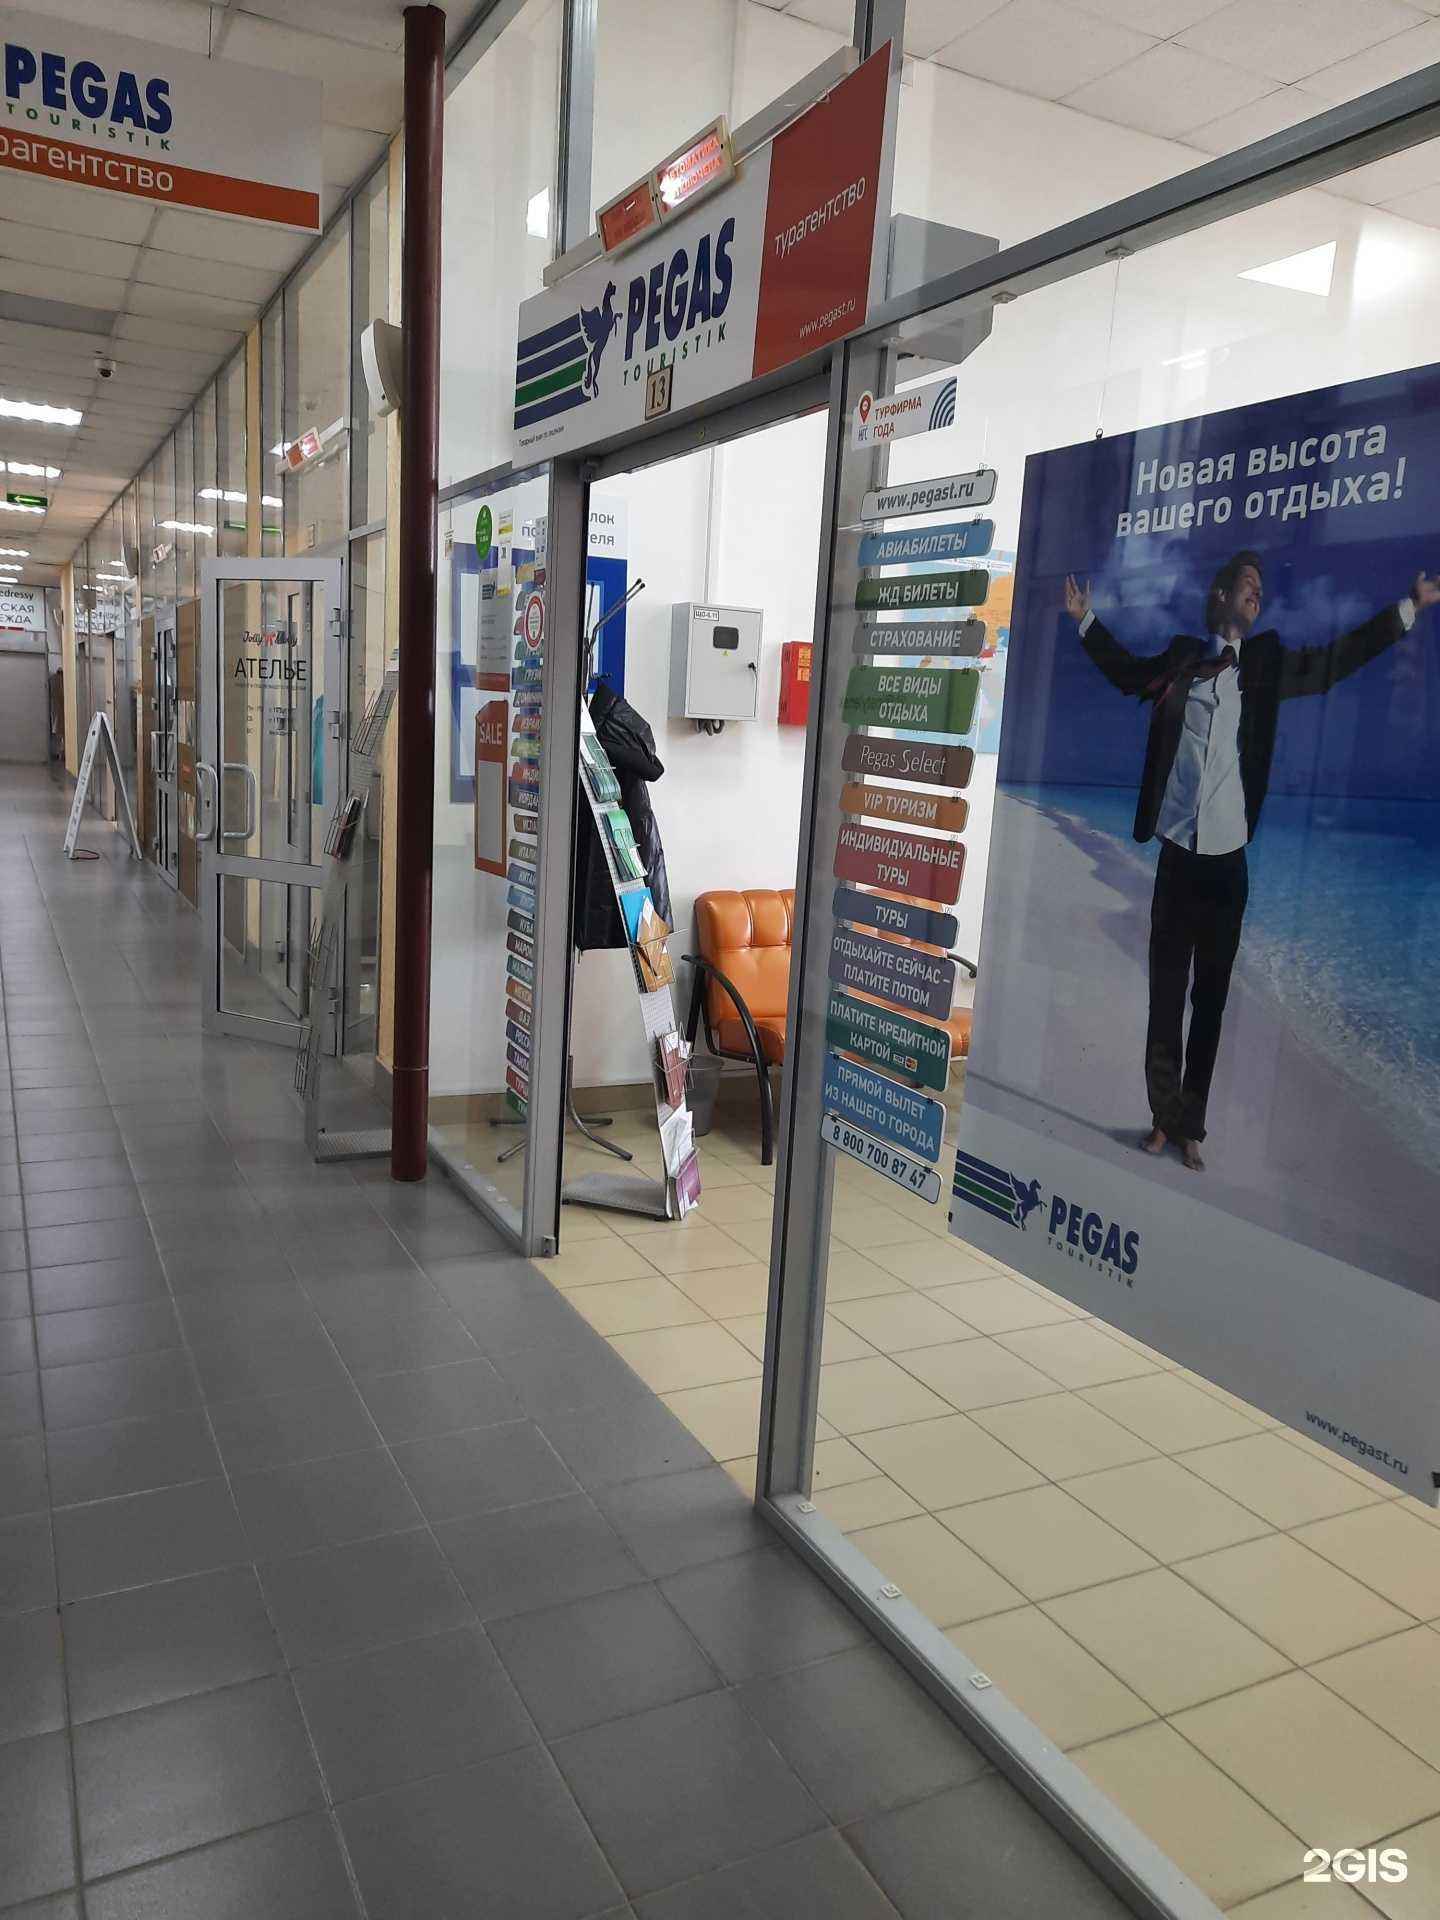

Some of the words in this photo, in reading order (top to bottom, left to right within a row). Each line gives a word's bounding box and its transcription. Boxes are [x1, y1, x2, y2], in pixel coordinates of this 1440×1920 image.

[5, 43, 173, 134] PEGAS
[6, 102, 171, 151] TOURISTIK
[774, 177, 867, 260] турагентство
[624, 216, 736, 362] PEGAS
[798, 297, 857, 339] www.pegast.ru
[622, 320, 727, 387] TOURISTIK
[649, 375, 667, 410] 13
[874, 395, 922, 421] ТУРФИРМА
[873, 421, 895, 439] ГОДА
[1136, 452, 1236, 496] Новая
[1246, 424, 1388, 477] высота
[876, 480, 976, 513] www.pegast.ru
[1116, 496, 1232, 538] вашего
[1244, 457, 1408, 521] отдыха!
[876, 531, 968, 560] АВИАБИЛЕТЫ
[877, 586, 901, 607] ЖД
[902, 580, 960, 603] БИЛЕТЫ
[869, 629, 963, 649] СТРАХОВАНИЕ
[234, 657, 307, 681] АТЕЛЬЕ
[878, 675, 902, 693] ВСЕ
[902, 676, 942, 698] ВИДЫ
[479, 721, 503, 745] SALE
[878, 702, 929, 725] ОТДЫХА
[860, 745, 896, 772] Pegas
[898, 749, 948, 777] Select
[863, 792, 884, 810] VIP
[885, 795, 939, 821] ТУРИЗМ
[840, 829, 961, 870] ИНДИВИДУАЛЬНЫЕ
[876, 863, 910, 888] ТУРЫ
[874, 904, 909, 929] ТУРЫ
[833, 935, 894, 972] ОТДЫХАЙТЕ
[895, 956, 942, 986] СЕЙЧАС
[843, 962, 891, 994] ПЛАТИТЕ
[891, 978, 931, 1009] ПОТОМ
[829, 999, 877, 1033] ПЛАТИТЕ
[877, 1018, 947, 1061] КРЕДИТНОЙ
[849, 1030, 892, 1063] КАРТОЙ
[836, 1064, 885, 1099] ПРЯМОЙ
[885, 1090, 927, 1121] ВЫЛЕТ
[825, 1082, 839, 1101] ИЗ
[840, 1092, 887, 1126] НАШЕГО
[888, 1114, 936, 1153] ГОРОДА
[832, 1125, 841, 1141] 8
[842, 1131, 864, 1155] 800
[866, 1143, 889, 1170] 700
[891, 1156, 908, 1179] 87
[909, 1166, 927, 1191] 47
[1049, 1194, 1141, 1275] PEGAS
[1047, 1236, 1134, 1288] TOURISTIK
[1305, 1410, 1409, 1475] www.pegast.ru
